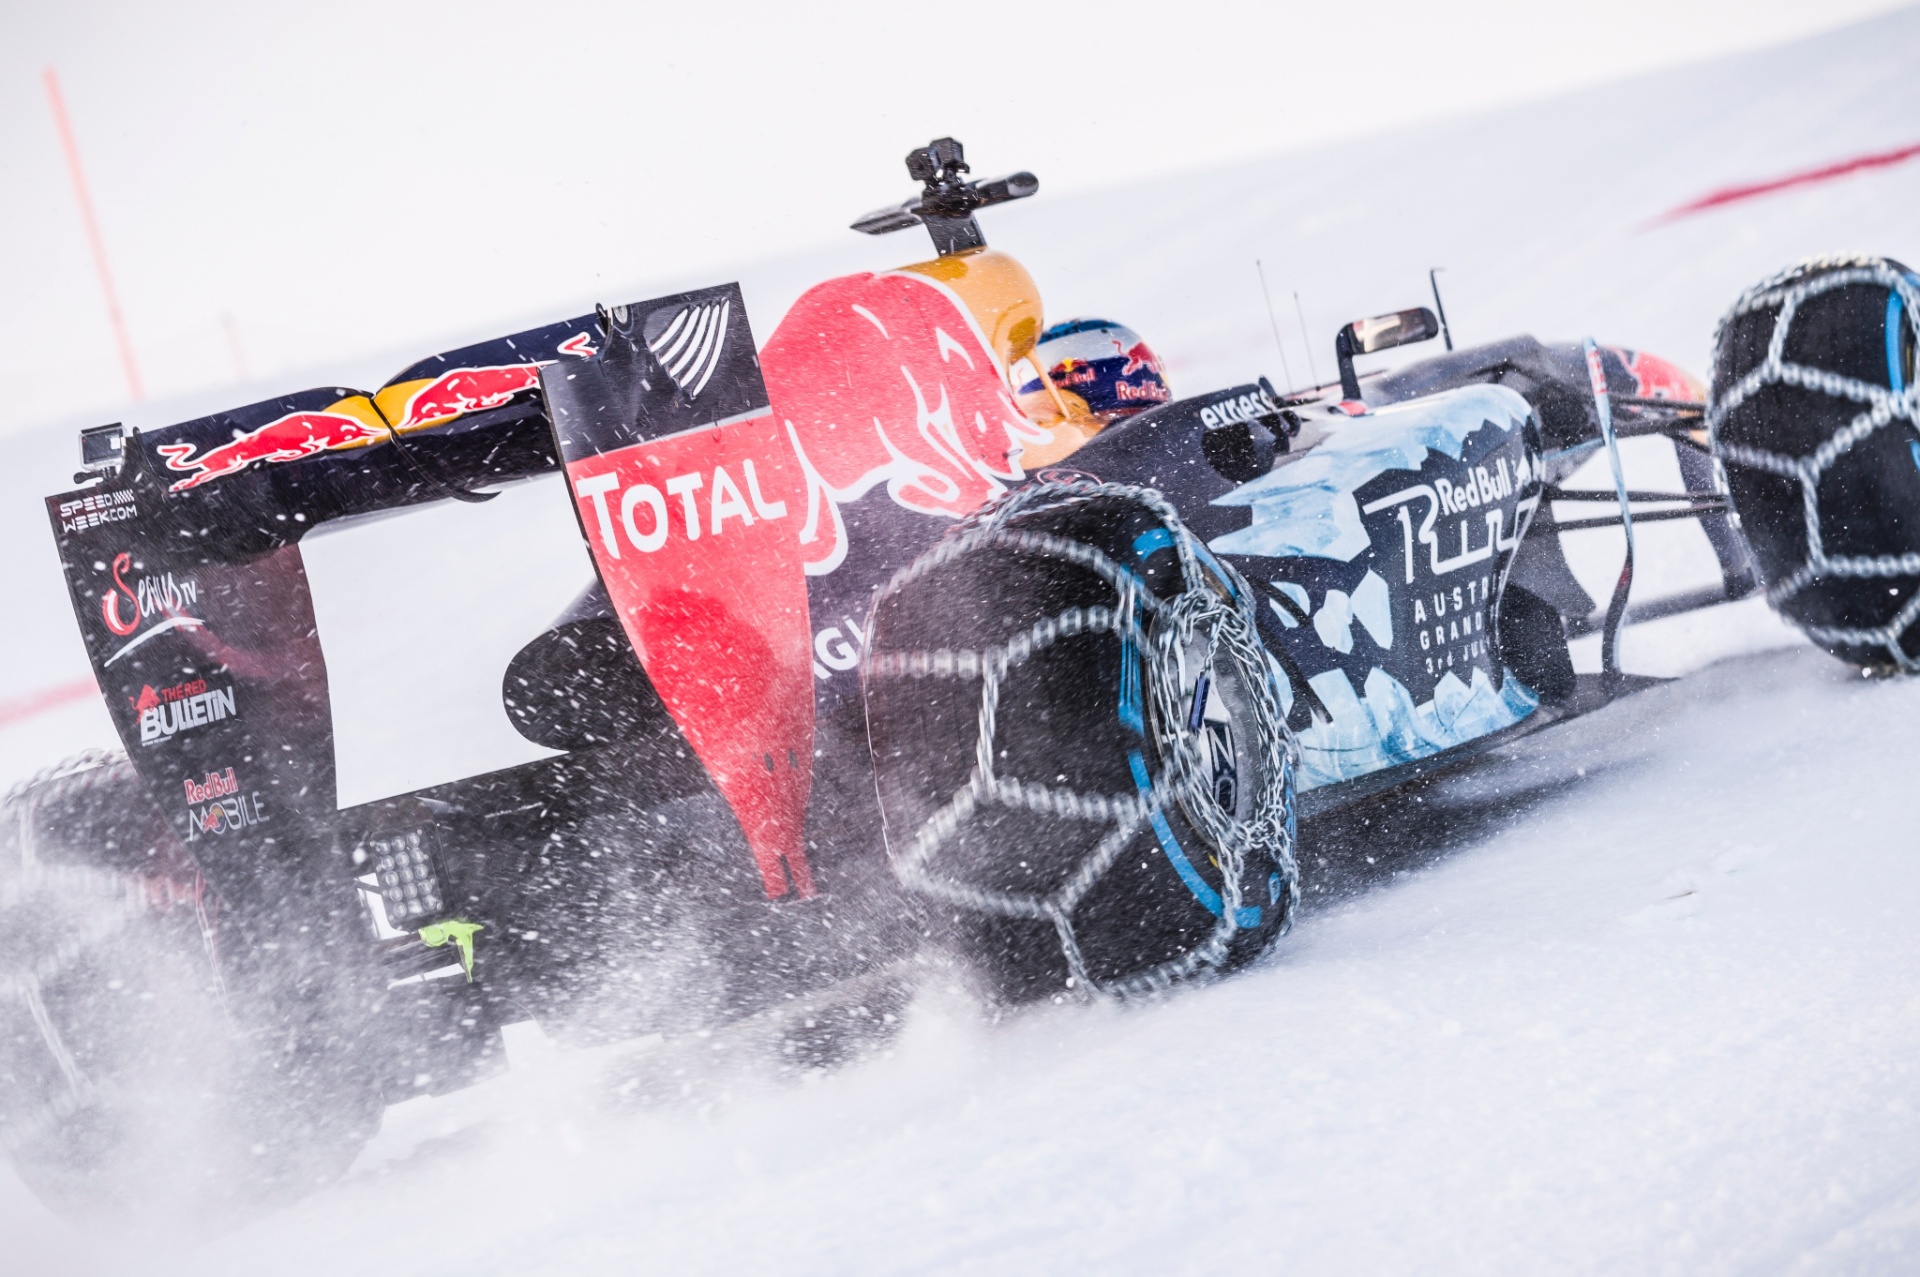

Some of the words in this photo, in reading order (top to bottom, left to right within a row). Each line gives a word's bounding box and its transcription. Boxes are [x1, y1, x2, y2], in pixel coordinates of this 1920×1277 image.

[1115, 379, 1148, 401] Red
[1434, 467, 1481, 517] Red
[1475, 457, 1512, 504] Bull
[60, 493, 113, 518] SPEED
[575, 458, 788, 560] TOTAL
[180, 580, 197, 606] TV
[1419, 610, 1483, 651] GRAND
[1425, 650, 1454, 675] 3rd
[161, 685, 185, 703] THE
[183, 678, 207, 699] RED
[183, 772, 214, 806] Red
[211, 766, 239, 798] Bull
[188, 790, 271, 842] MOBILE
